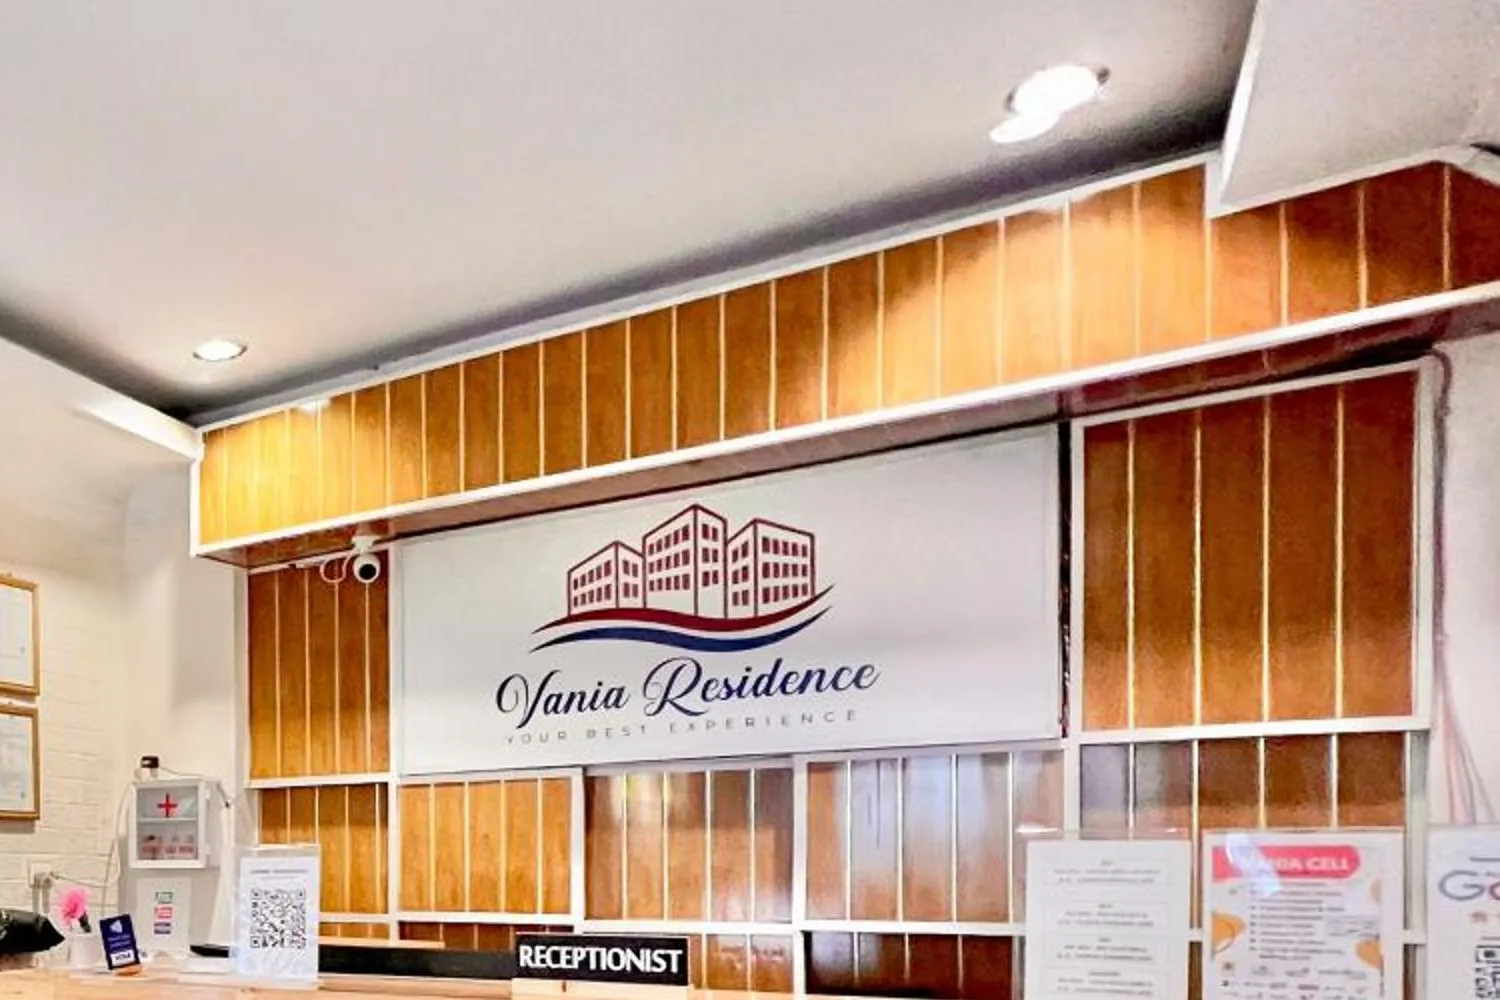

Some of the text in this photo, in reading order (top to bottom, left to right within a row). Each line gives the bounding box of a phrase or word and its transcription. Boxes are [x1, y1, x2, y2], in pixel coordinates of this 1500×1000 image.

[496, 657, 881, 729] Vania Residence
[507, 709, 857, 745] YOUR BEST EXPERIENCE
[518, 944, 683, 974] RECEPTIONIST
